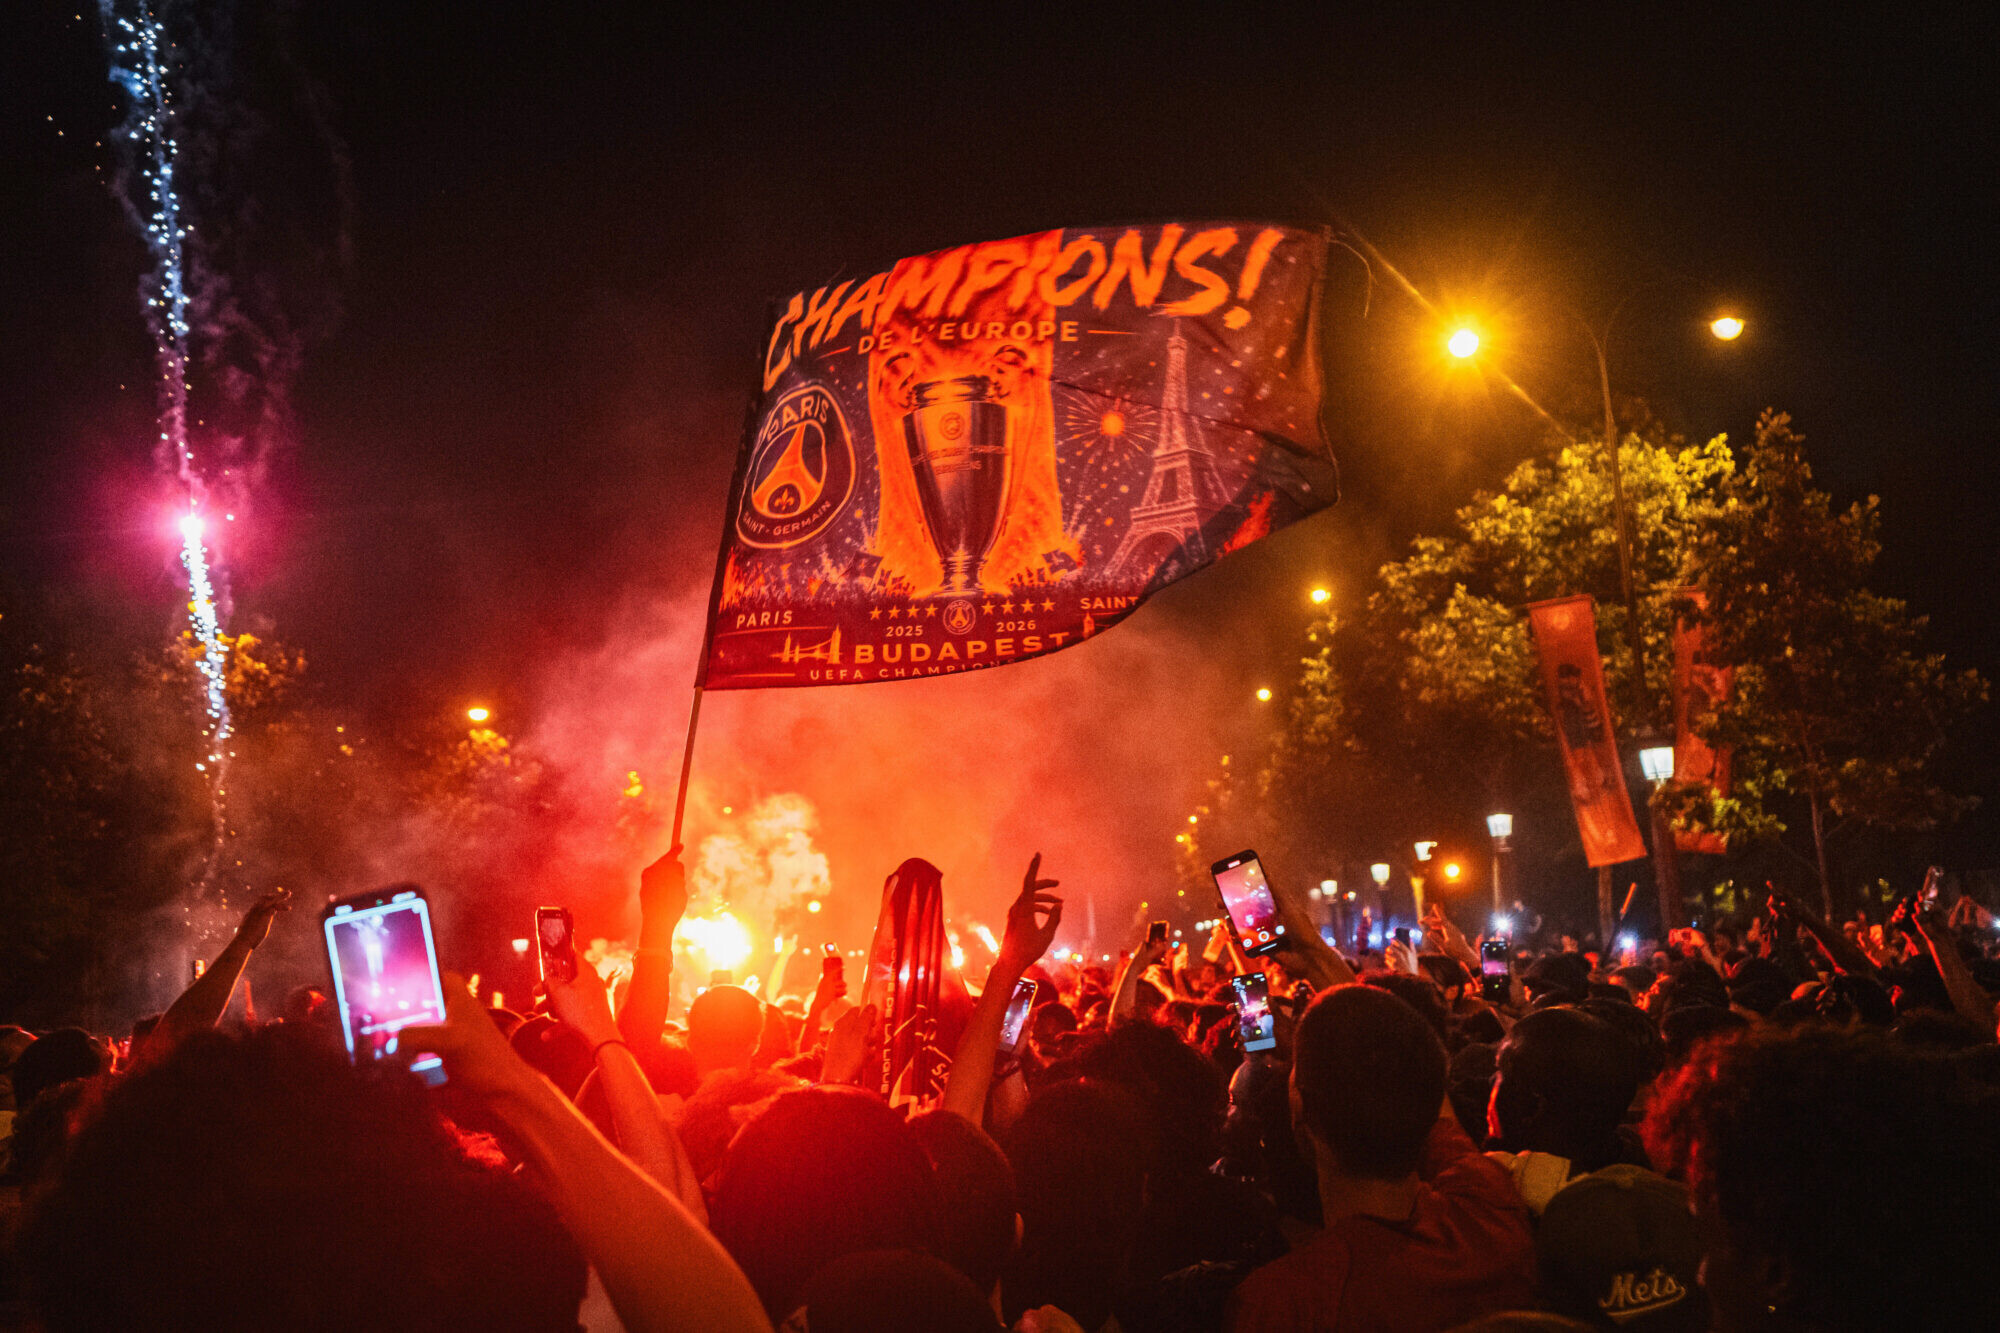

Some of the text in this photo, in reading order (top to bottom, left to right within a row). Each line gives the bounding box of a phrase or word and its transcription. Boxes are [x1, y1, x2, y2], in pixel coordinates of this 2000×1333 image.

[763, 223, 1285, 392] CHAMPIONS!
[858, 320, 1079, 354] DE L'EUROPE
[767, 394, 830, 441] PARIS
[1080, 596, 1138, 609] SAINT
[736, 610, 793, 629] PARIS
[886, 624, 924, 637] 2025
[996, 620, 1036, 632] 2026
[855, 632, 1069, 664] BUDAPEST
[810, 669, 863, 680] UEFA
[885, 997, 894, 1018] DE
[884, 1023, 892, 1045] LA
[881, 1049, 891, 1094] LIGUE
[1599, 1268, 1681, 1309] Mets
